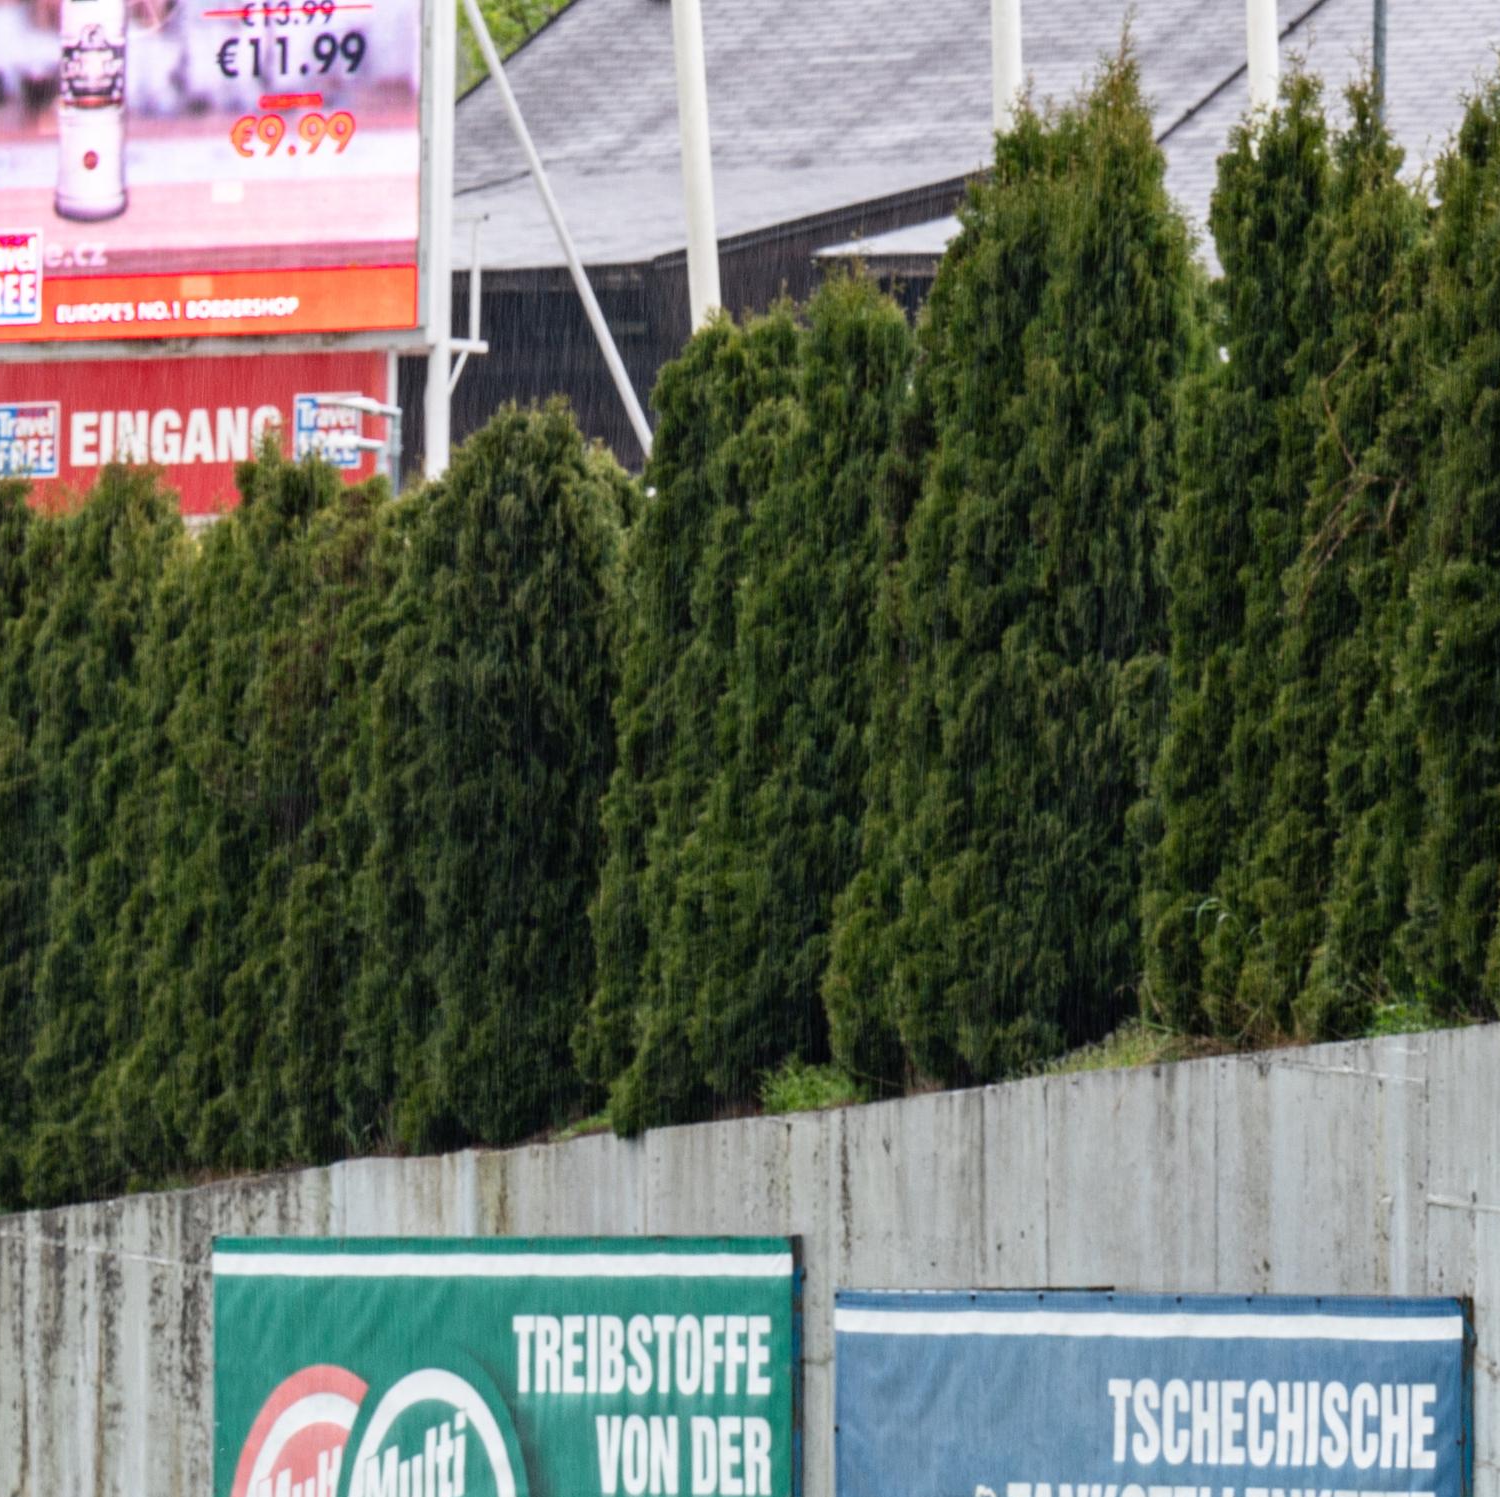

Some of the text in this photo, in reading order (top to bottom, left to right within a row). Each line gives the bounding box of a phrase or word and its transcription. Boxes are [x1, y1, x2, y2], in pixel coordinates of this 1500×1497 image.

[216, 32, 367, 78] €11.99
[230, 111, 356, 158] €9.99
[512, 1313, 773, 1397] TREIBSTOFFE
[595, 1413, 773, 1497] VON DER
[1107, 1377, 1437, 1470] TSCHECHISCHE
